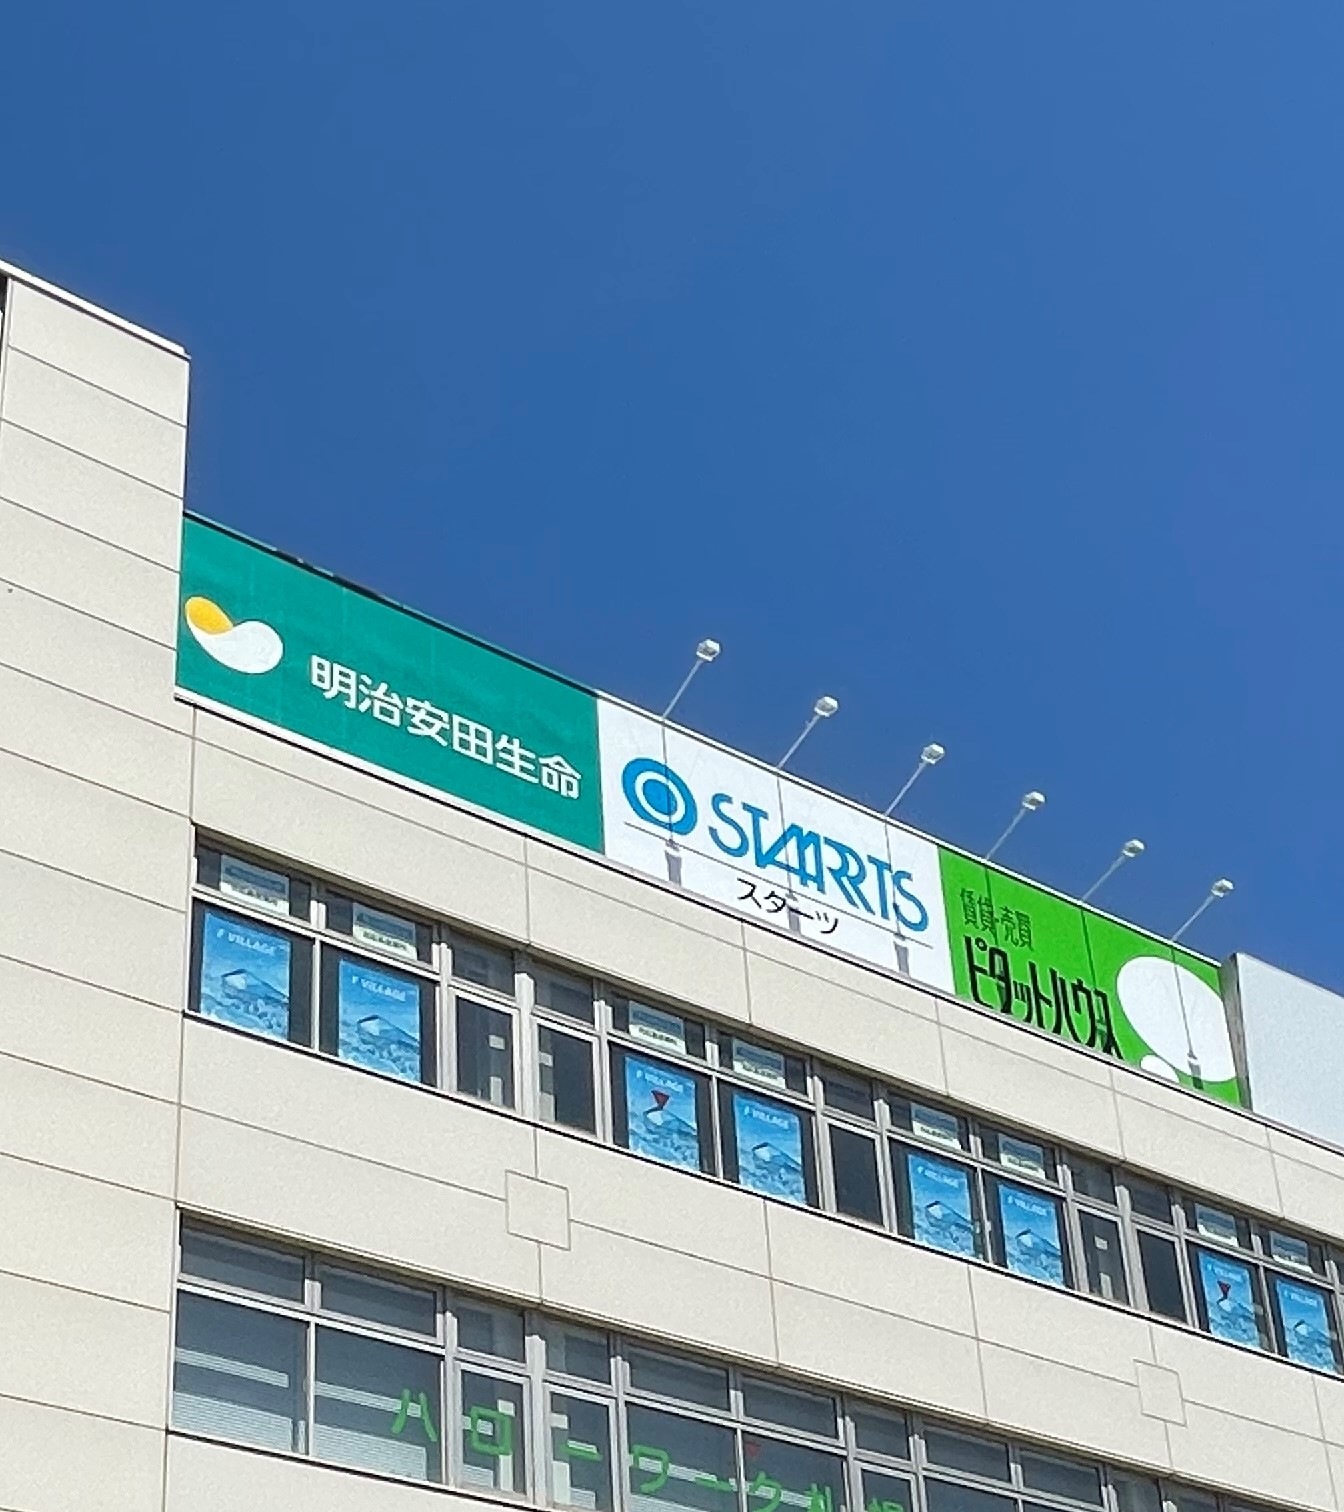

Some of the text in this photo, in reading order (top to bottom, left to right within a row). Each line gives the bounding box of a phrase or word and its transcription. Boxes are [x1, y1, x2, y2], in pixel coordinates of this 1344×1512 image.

[310, 653, 582, 800] 明治安田生命
[709, 792, 929, 932] STARTS
[736, 877, 840, 935] スターツ
[963, 934, 1125, 1060] ピタットハウス
